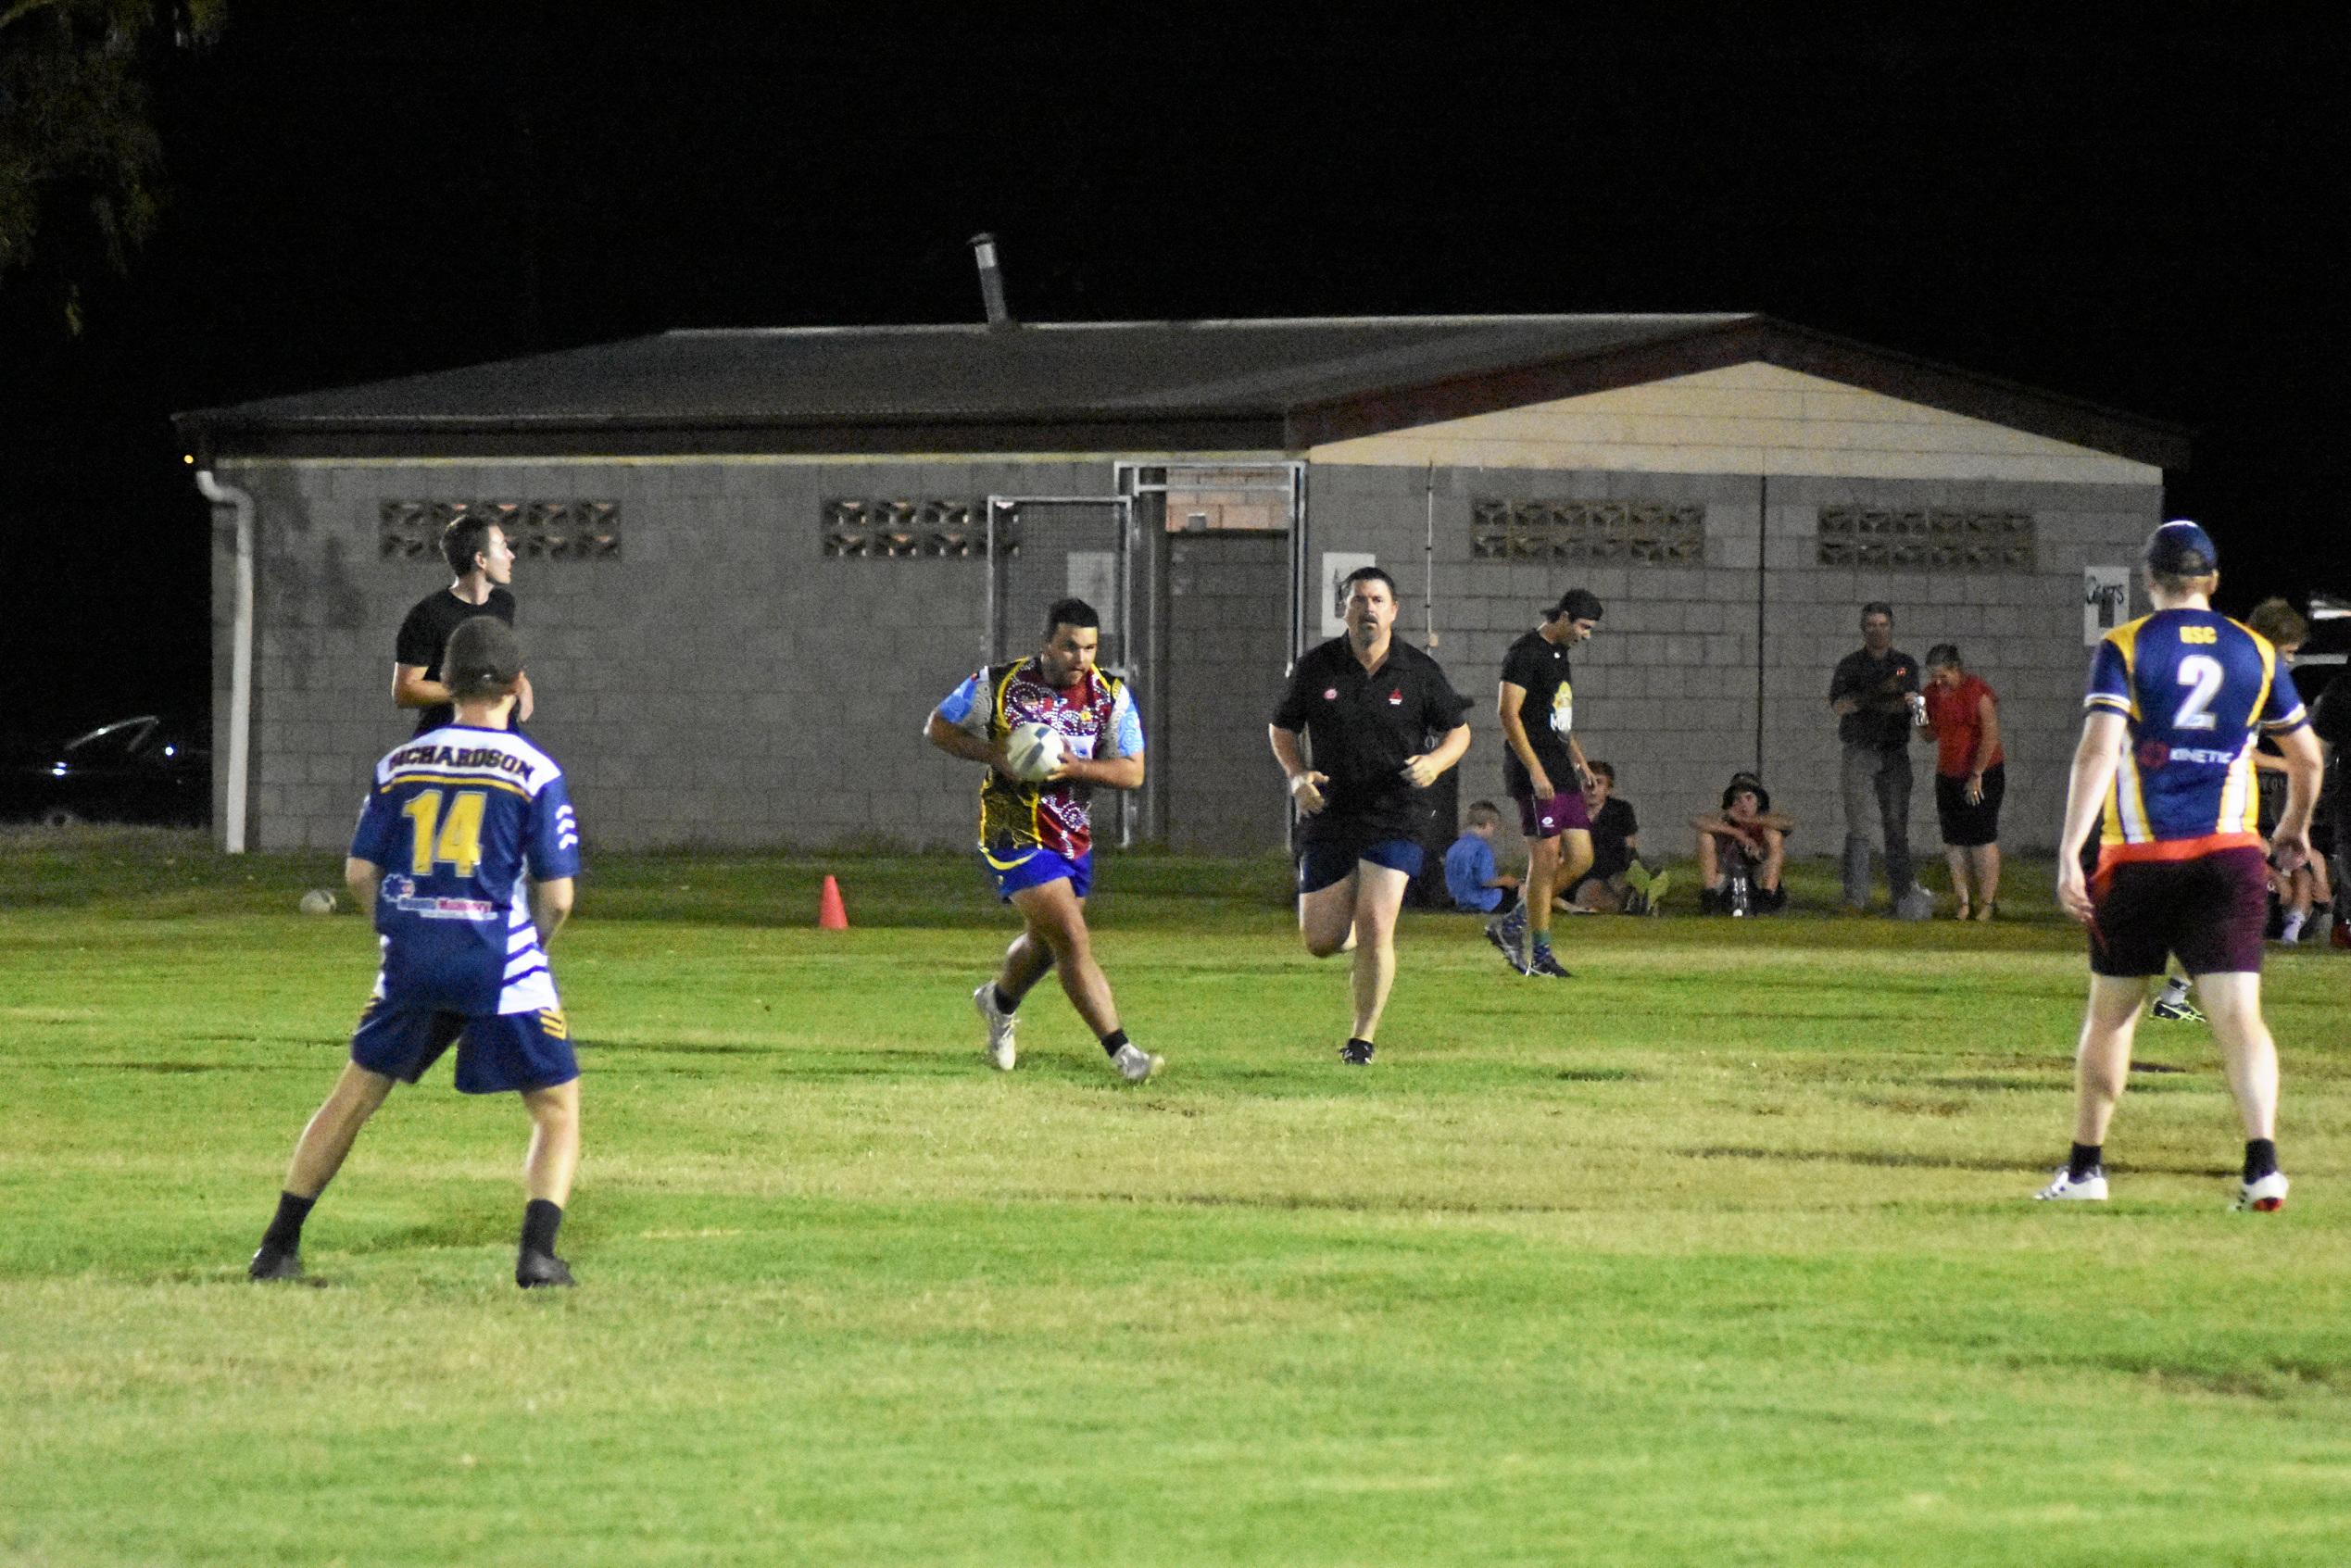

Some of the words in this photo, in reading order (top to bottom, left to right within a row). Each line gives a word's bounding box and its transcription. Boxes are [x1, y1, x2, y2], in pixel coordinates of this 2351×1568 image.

[2172, 654, 2223, 731] 2
[387, 745, 535, 782] RICHARDSON
[401, 788, 488, 878] 14
